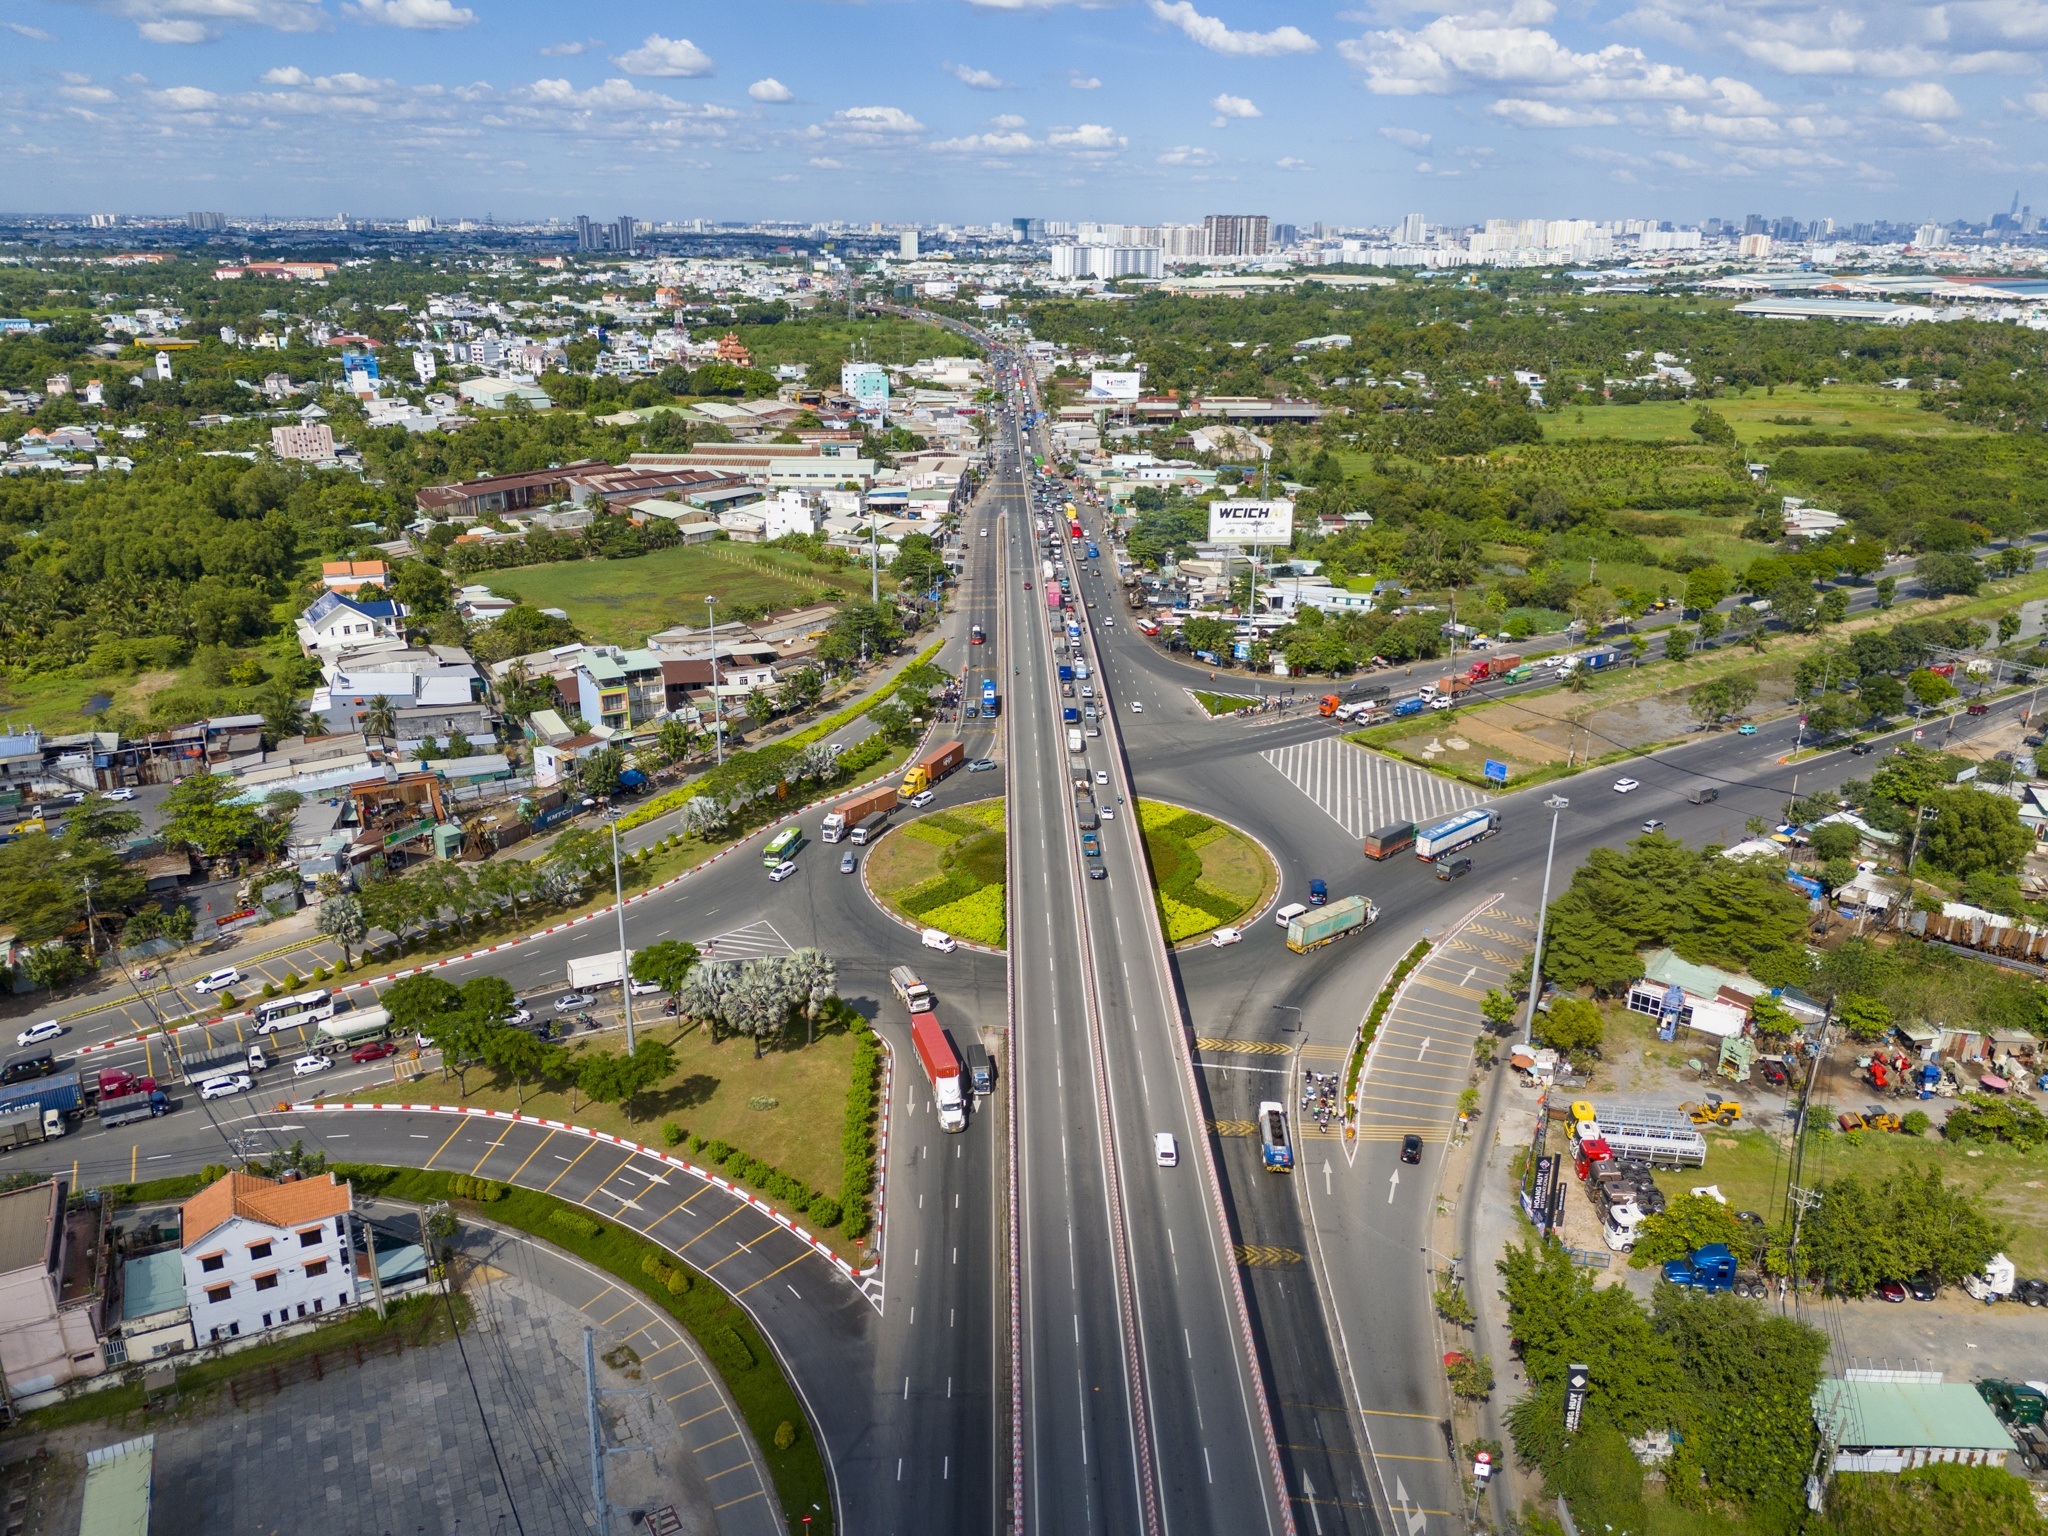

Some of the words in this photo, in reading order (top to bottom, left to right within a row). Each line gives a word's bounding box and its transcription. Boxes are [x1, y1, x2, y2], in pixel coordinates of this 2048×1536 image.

[1536, 1172, 1544, 1186] HUY
[1533, 1186, 1542, 1209] HOANG
[1540, 1173, 1548, 1209] INTERNATIONAL
[1568, 1392, 1578, 1410] HUY
